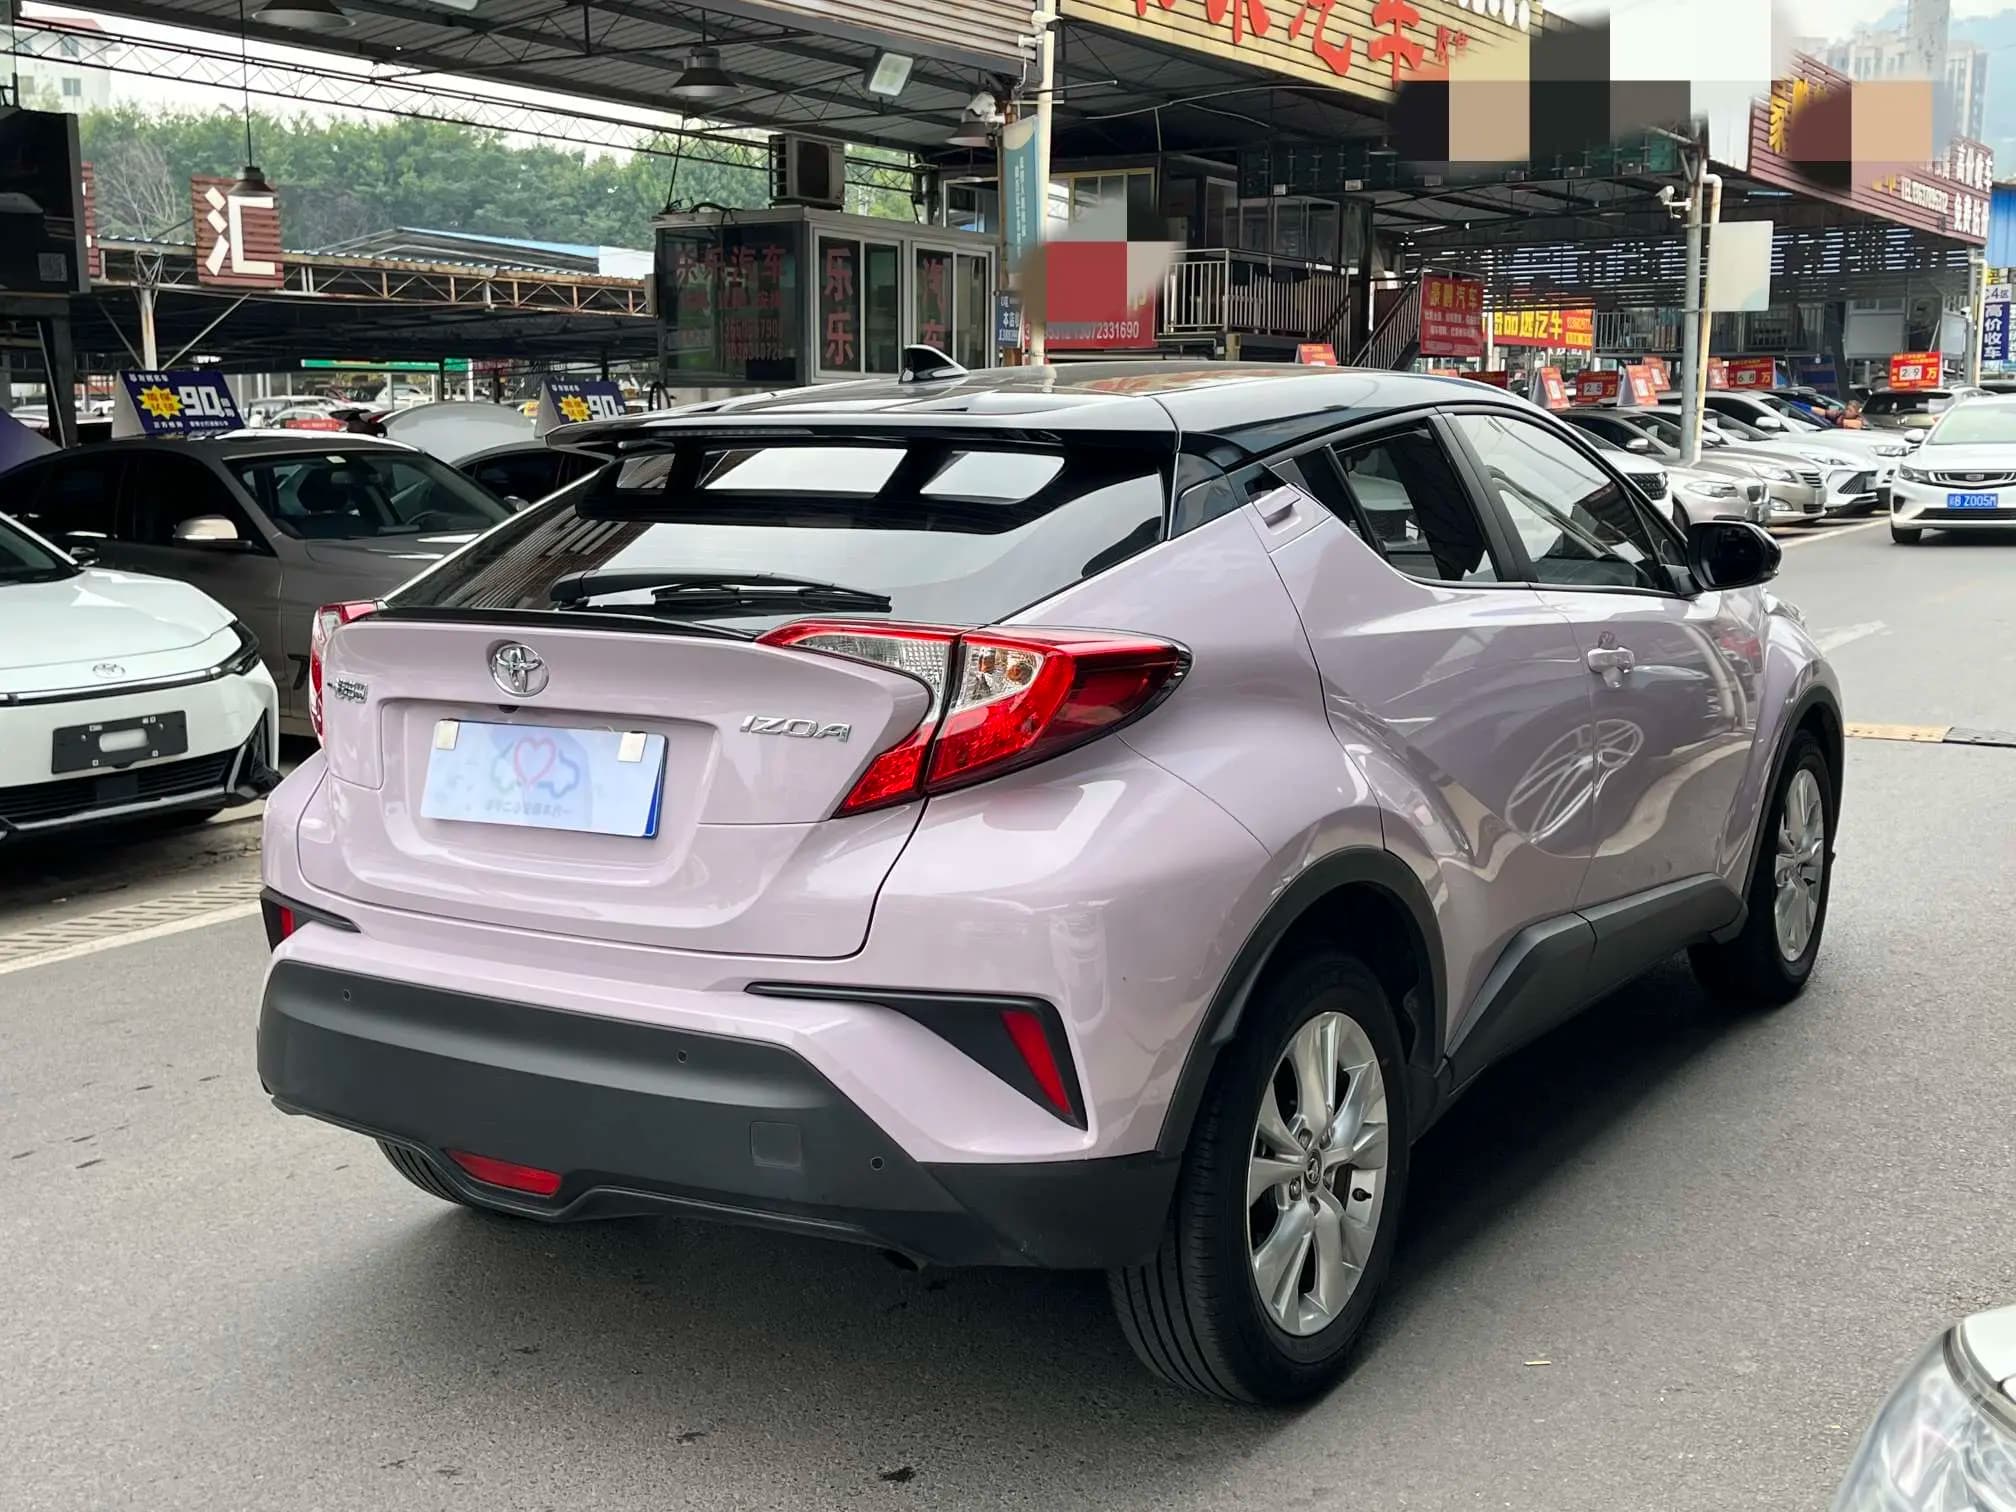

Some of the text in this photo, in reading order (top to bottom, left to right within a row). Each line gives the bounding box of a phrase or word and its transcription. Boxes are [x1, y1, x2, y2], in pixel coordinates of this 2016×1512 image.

[204, 186, 276, 276] 汇
[823, 247, 854, 366] 乐乐
[1983, 304, 2003, 359] 高价收车
[739, 715, 852, 743] IZOA
